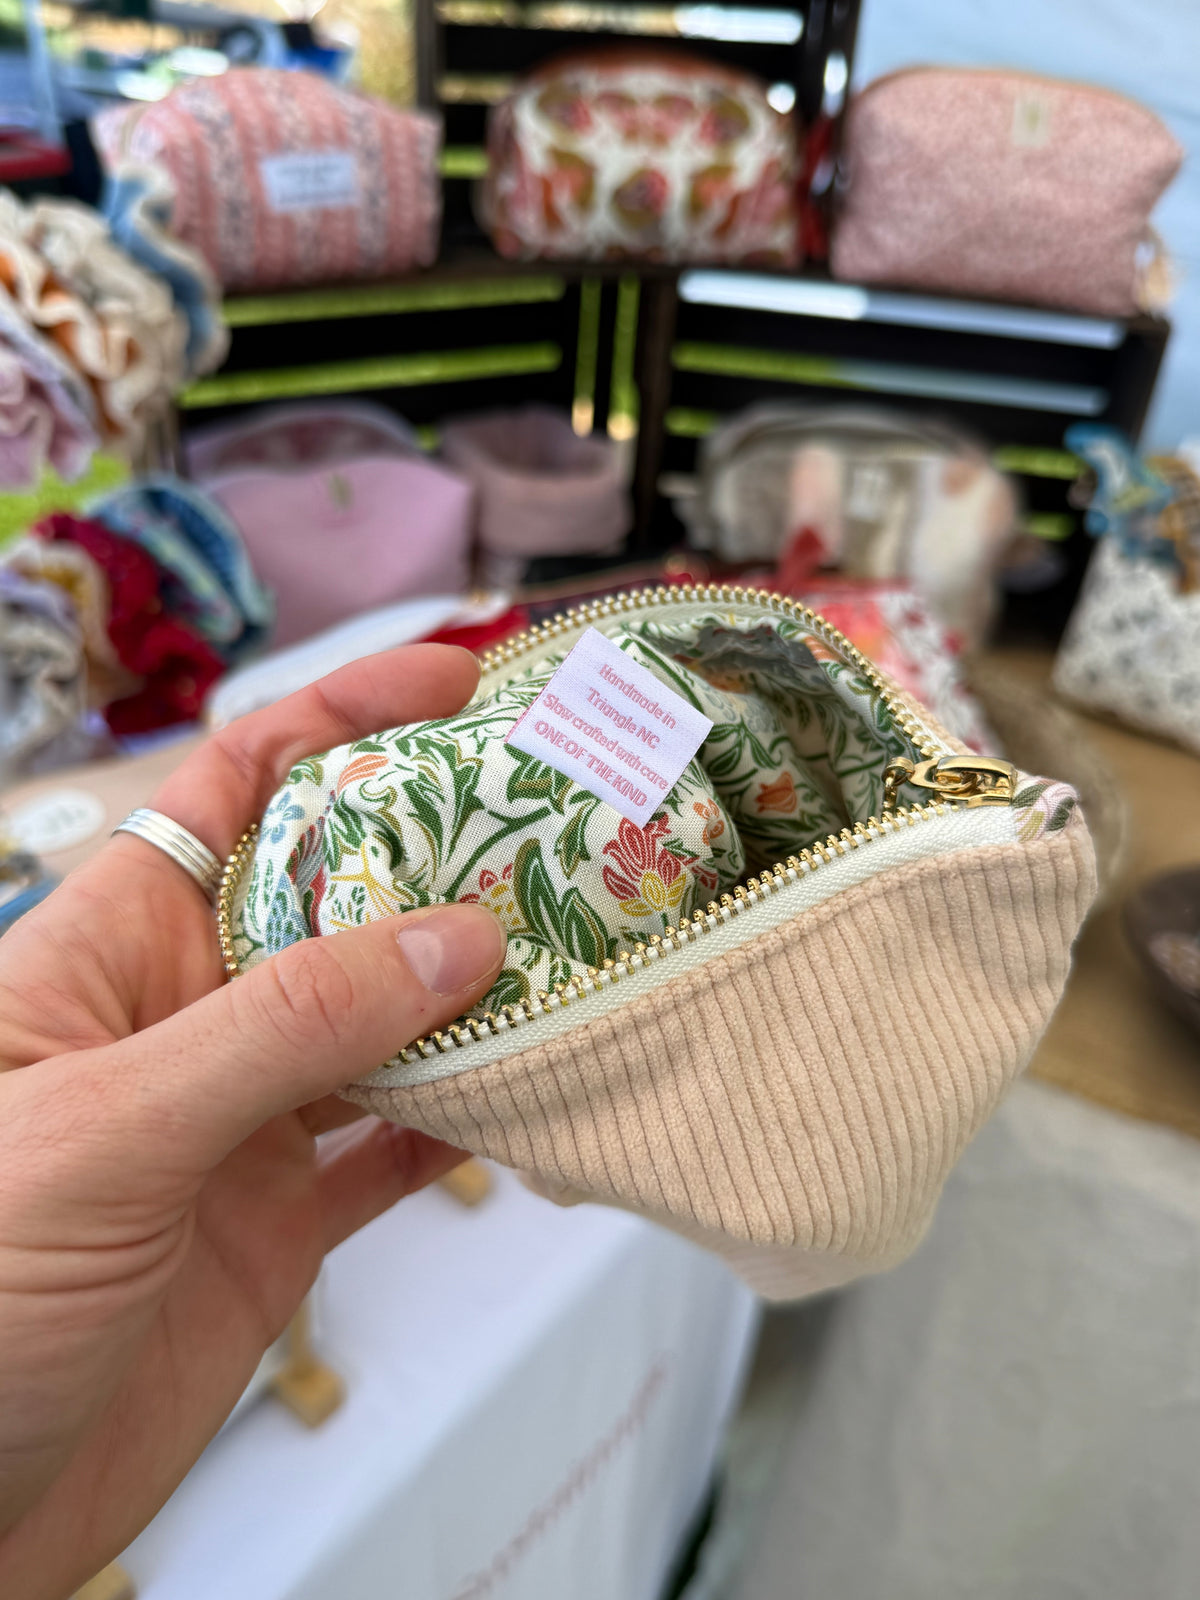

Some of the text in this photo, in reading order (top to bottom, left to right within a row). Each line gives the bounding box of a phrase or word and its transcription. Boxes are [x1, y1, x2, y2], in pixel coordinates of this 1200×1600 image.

[587, 688, 660, 749] Triangle NC
[599, 664, 677, 729] Handmade in
[535, 721, 647, 807] ONE OF THE KIND
[543, 694, 668, 790] Slow crafted with care
